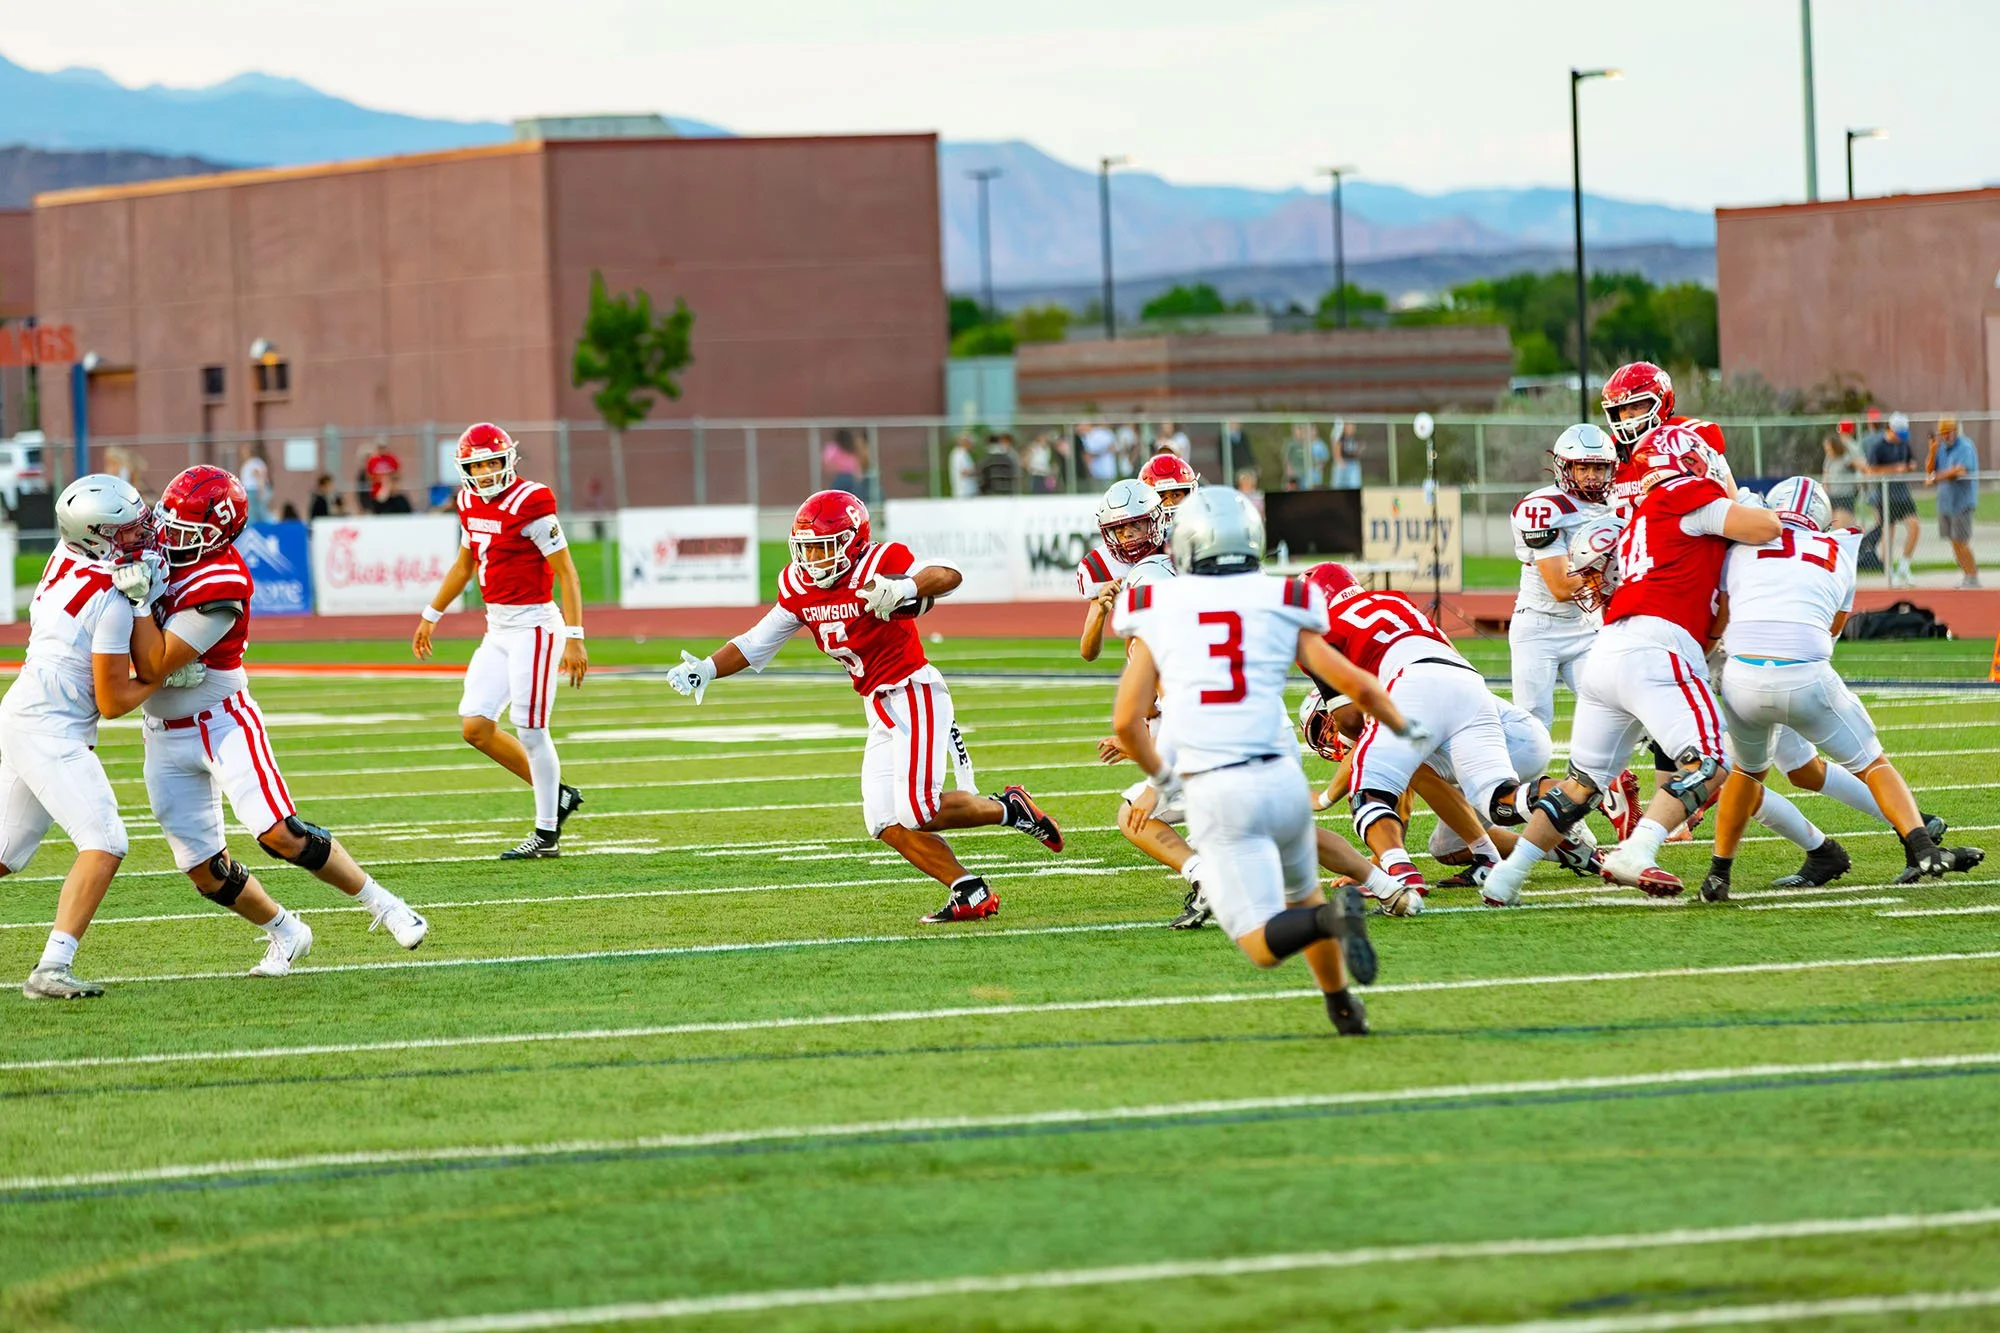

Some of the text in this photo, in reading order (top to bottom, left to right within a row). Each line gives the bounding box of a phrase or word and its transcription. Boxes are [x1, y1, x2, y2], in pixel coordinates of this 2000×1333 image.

[213, 496, 237, 526] 51
[1525, 506, 1552, 529] 42
[471, 531, 492, 587] 7
[801, 602, 861, 623] CRIMSON
[818, 620, 865, 679] 6
[1198, 610, 1247, 705] 3
[968, 886, 987, 909] NIKE
